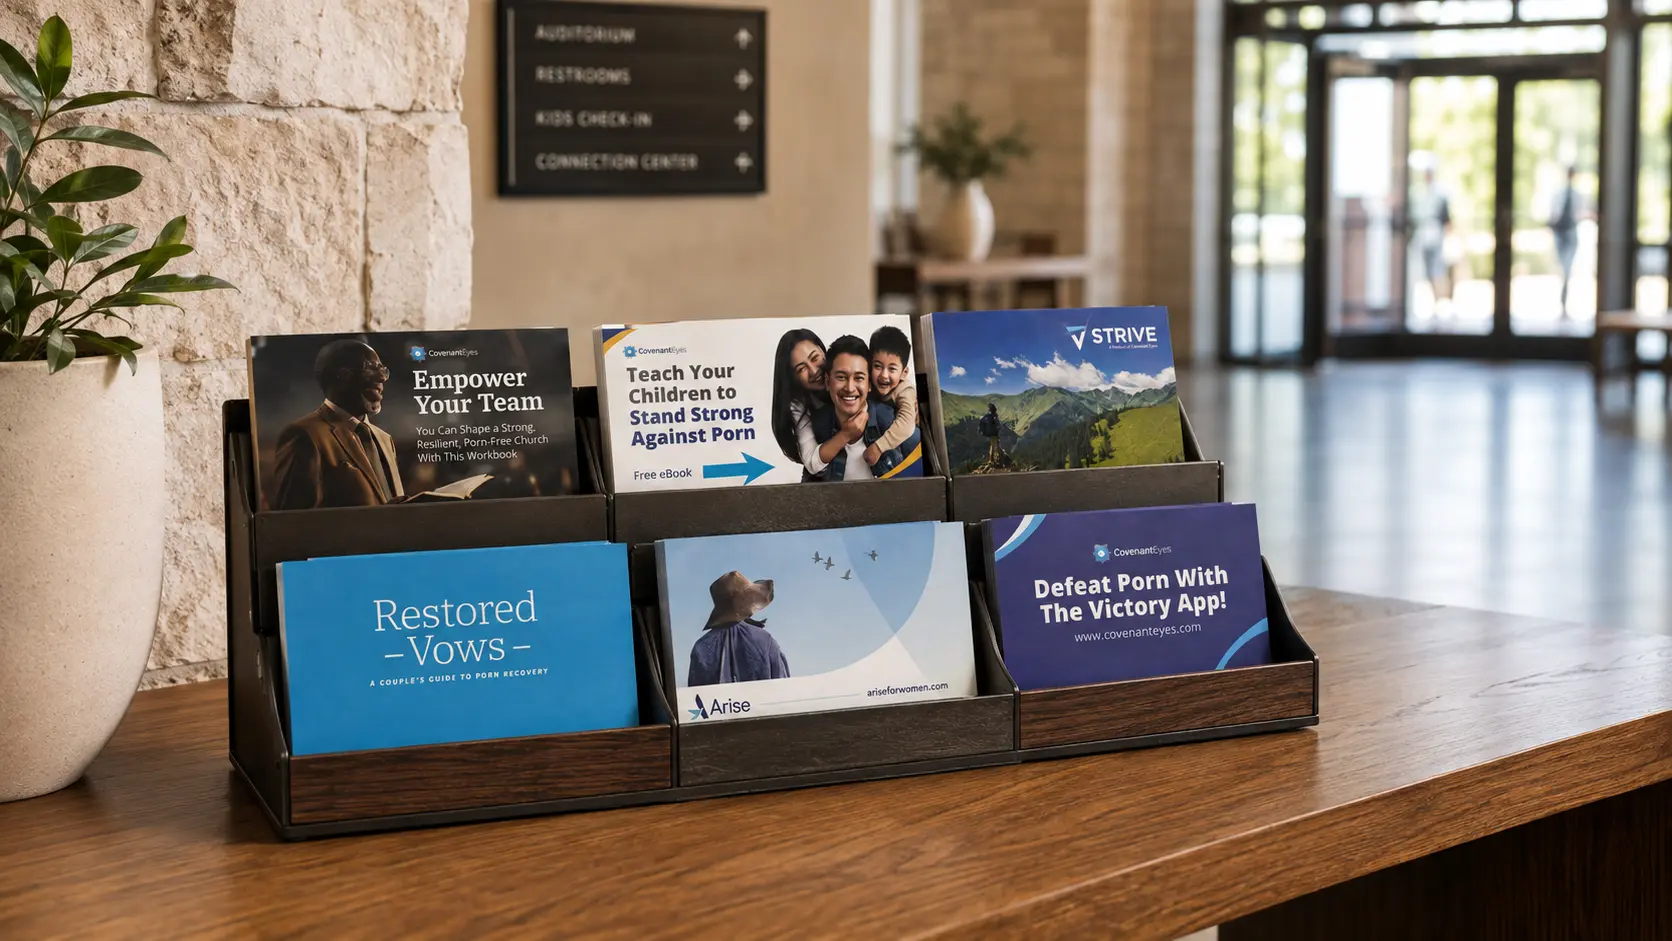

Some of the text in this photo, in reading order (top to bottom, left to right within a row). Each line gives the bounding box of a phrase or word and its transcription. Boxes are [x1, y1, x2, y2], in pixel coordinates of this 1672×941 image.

[535, 25, 636, 44] AUDITORIUM
[535, 66, 631, 85] RESTROOMS
[535, 110, 652, 128] KIDS CHECK-IN
[535, 152, 699, 171] CONNECTION CENTER
[1091, 327, 1158, 344] STRIVE
[428, 349, 479, 358] CovenantEyes
[638, 346, 687, 355] CovenantEyes
[412, 370, 528, 395] Empower
[626, 364, 735, 383] Teach Your
[413, 393, 545, 415] Your Team
[628, 385, 737, 404] Children to
[630, 406, 755, 426] Stand Strong
[415, 426, 435, 436] You
[438, 425, 458, 435] Can
[459, 424, 491, 437] Shape
[493, 425, 499, 434] a
[631, 426, 756, 450] Against Porn
[417, 434, 549, 450] Resilient, Porn-Free Church
[417, 449, 518, 463] With This Workbook
[634, 468, 692, 481] Free eBook
[1113, 544, 1172, 557] CovenantEyes
[1034, 565, 1229, 599] Defeat Porn With
[373, 589, 538, 632] Restored
[1039, 590, 1227, 624] The Victory App!
[1074, 623, 1202, 643] www.covenanteyes.com
[379, 676, 425, 687] COUPLE'S
[428, 674, 456, 683] GUIDE
[460, 672, 472, 681] TO
[475, 670, 500, 679] PORN
[503, 667, 548, 677] RECOVERY
[866, 681, 949, 698] ariseforwomen.com
[709, 698, 751, 717] Arise
